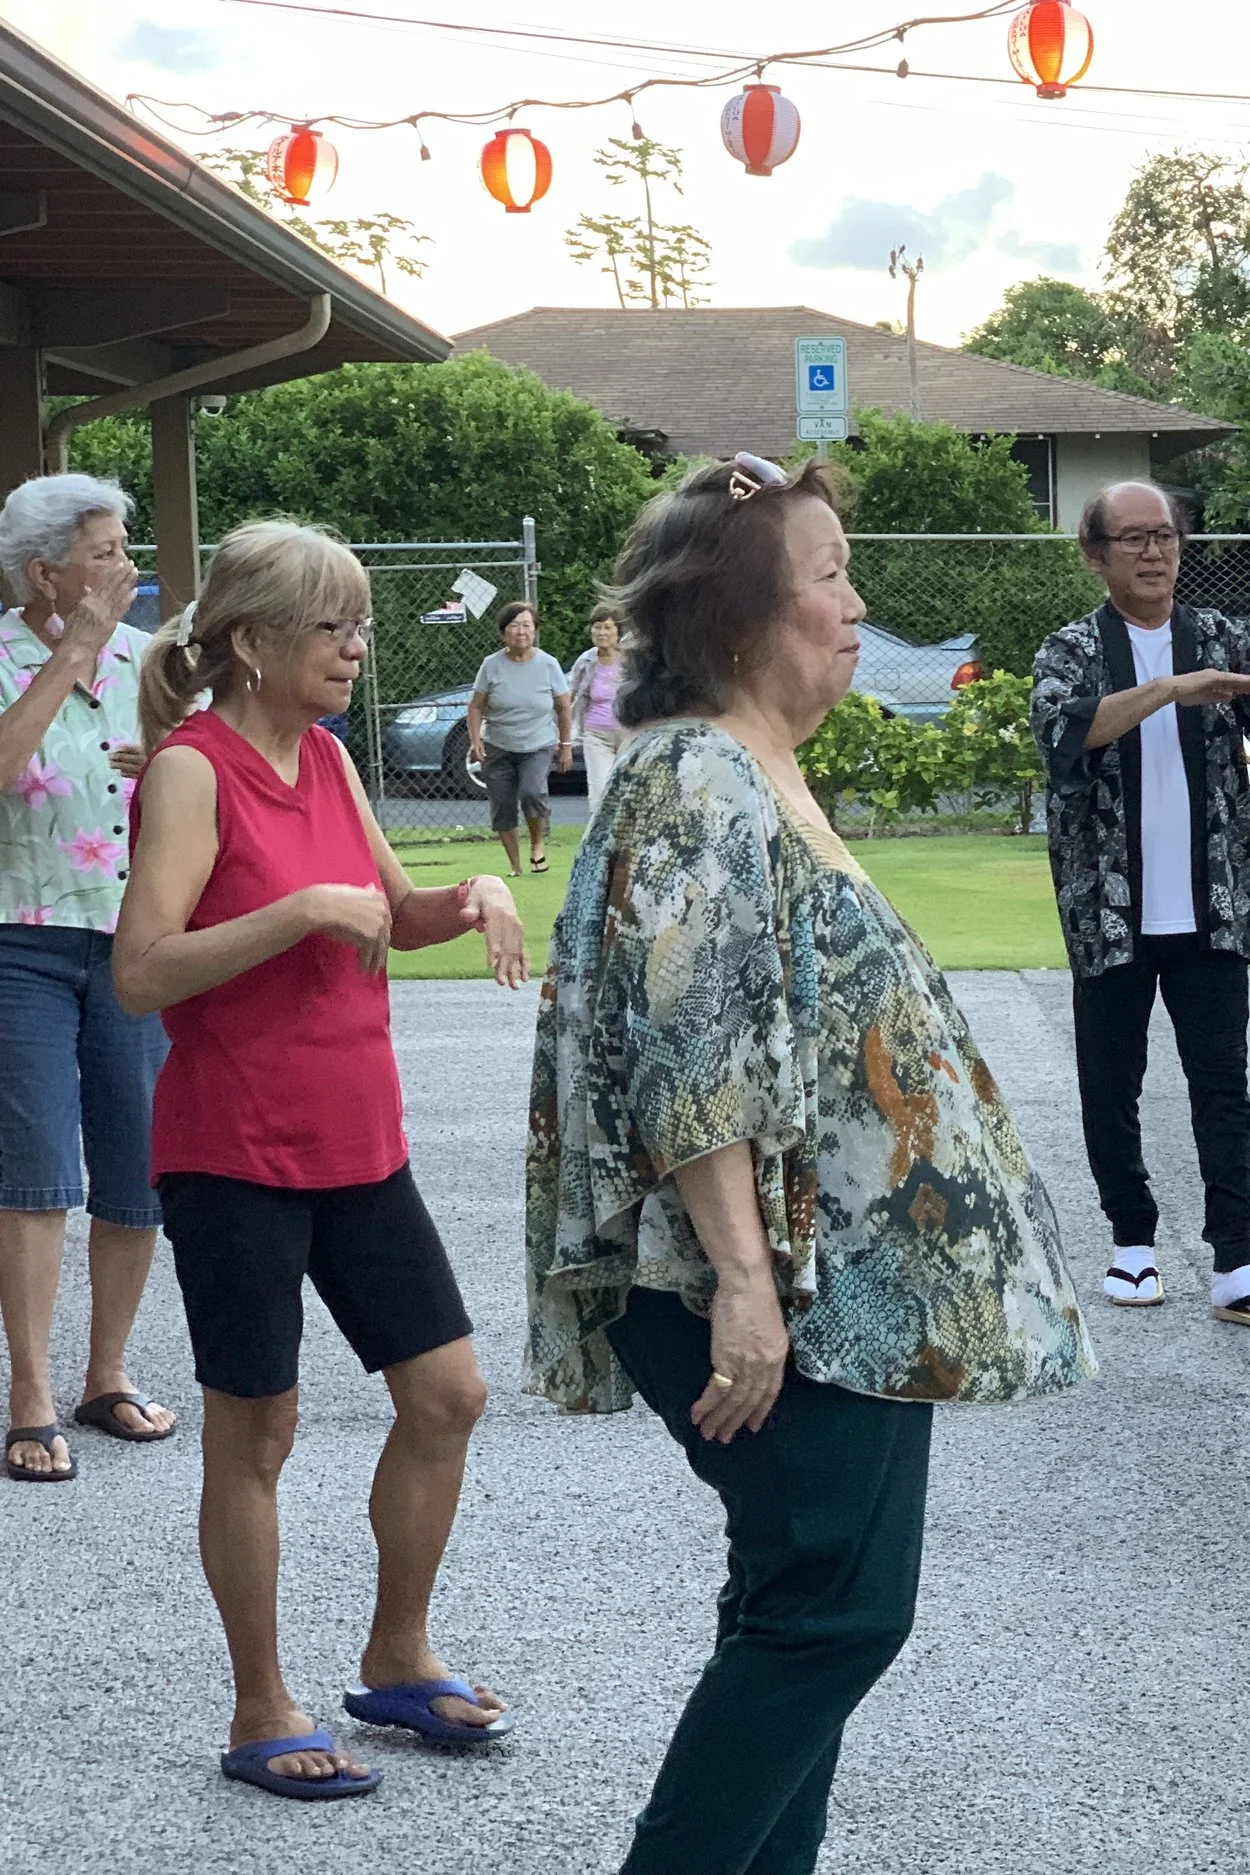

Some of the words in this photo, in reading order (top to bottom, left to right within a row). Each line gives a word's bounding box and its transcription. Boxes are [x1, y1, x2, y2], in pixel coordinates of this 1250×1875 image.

[800, 344, 842, 354] RESERVED
[804, 354, 838, 364] PARKING
[814, 421, 832, 429] VAN
